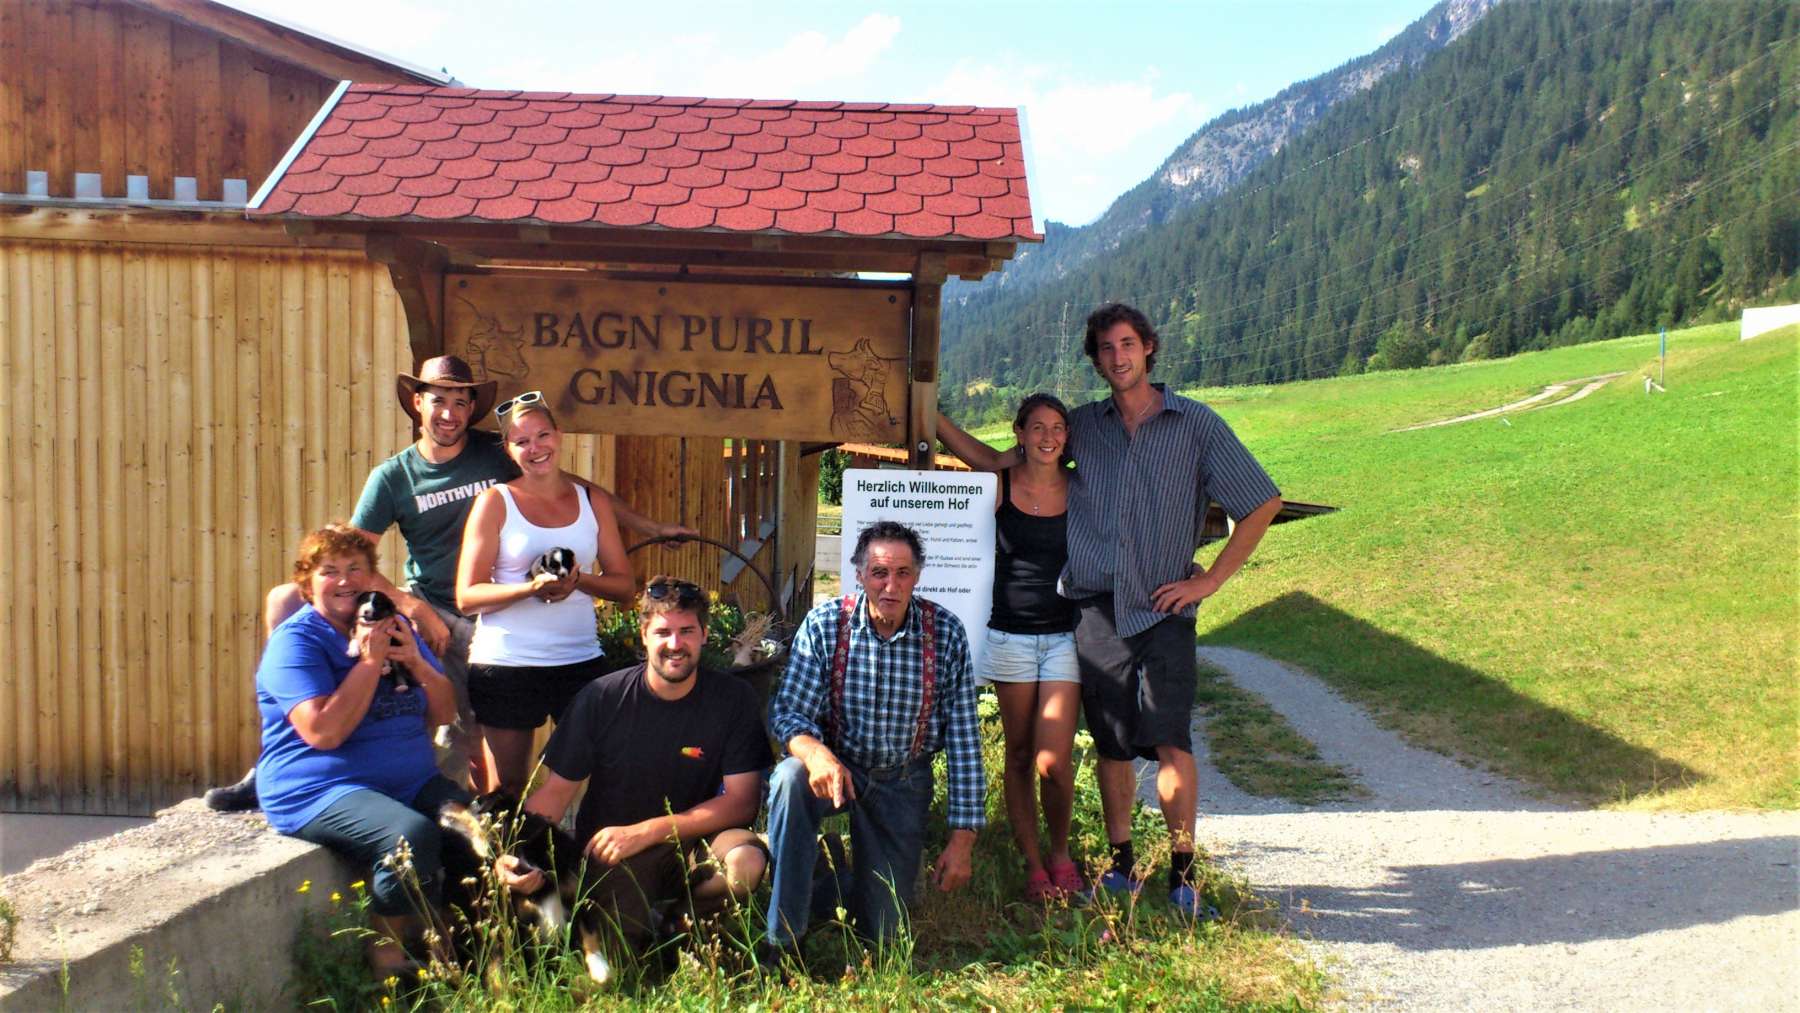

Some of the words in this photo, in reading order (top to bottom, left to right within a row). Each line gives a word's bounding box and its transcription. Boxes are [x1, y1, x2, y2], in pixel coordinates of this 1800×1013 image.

[532, 312, 663, 351] BAGN
[682, 314, 824, 356] PURIL
[570, 368, 784, 410] GNIGNIA
[857, 479, 905, 493] Herzlich
[909, 481, 983, 495] Willkommen
[870, 496, 890, 508] auf
[892, 499, 944, 509] unserem
[949, 498, 970, 510] Hof
